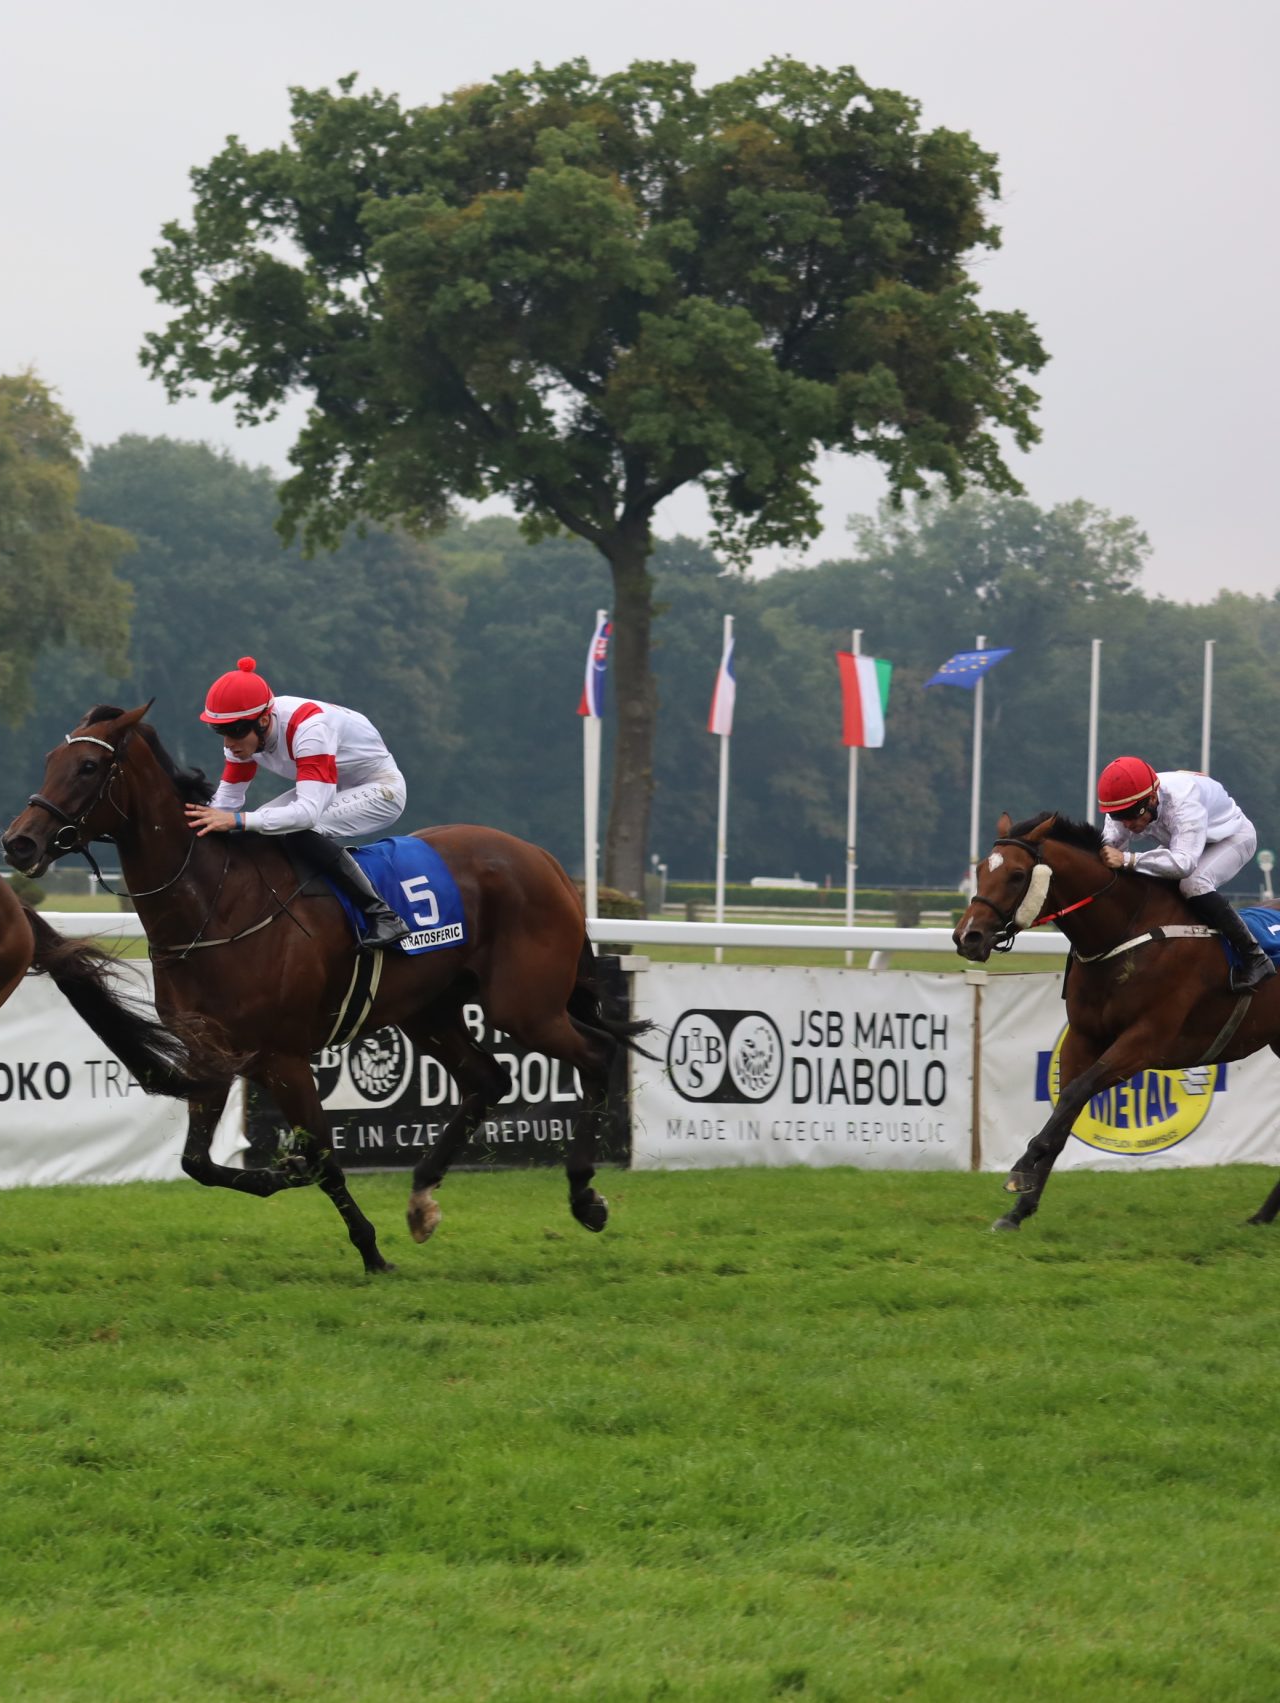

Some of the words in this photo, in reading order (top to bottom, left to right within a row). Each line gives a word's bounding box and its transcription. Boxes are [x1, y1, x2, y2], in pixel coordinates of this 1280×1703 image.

[400, 875, 439, 927] 5
[792, 1010, 843, 1048] JSB
[855, 1012, 948, 1050] MATCH
[420, 1052, 584, 1106] DIBOL
[792, 1057, 947, 1107] DIABOLO
[1089, 1071, 1178, 1129] METAL
[358, 1125, 384, 1148] IN
[396, 1122, 460, 1147] CZE
[484, 1118, 590, 1143] REPUBL
[666, 1119, 726, 1140] MADE
[738, 1120, 760, 1140] IN
[772, 1121, 836, 1141] CZECH
[847, 1121, 946, 1142] REPUBLIC
